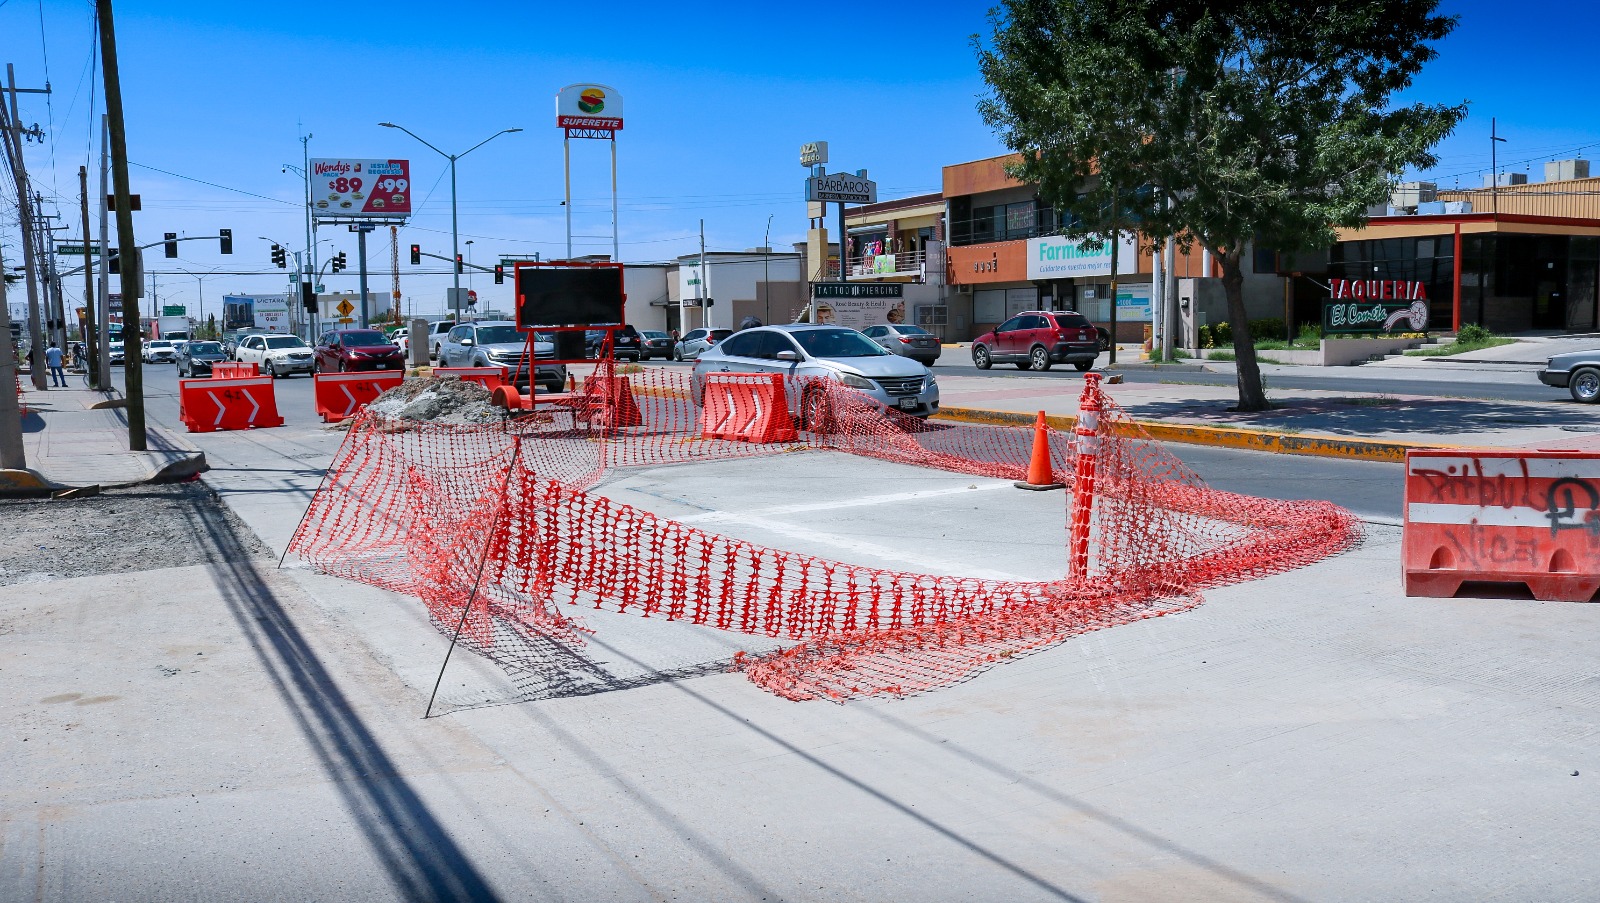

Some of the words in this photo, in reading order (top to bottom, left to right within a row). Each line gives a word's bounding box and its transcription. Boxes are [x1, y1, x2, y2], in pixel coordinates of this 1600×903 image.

[562, 117, 620, 127] SUPERETTE
[314, 160, 351, 175] Wendy's
[328, 177, 363, 193] $89
[378, 178, 408, 193] $99
[817, 179, 870, 193] BÁRBAROS
[817, 286, 850, 295] TATTOO
[861, 286, 899, 295] PIERCING
[1328, 278, 1427, 303] TAQUERIA
[1331, 303, 1346, 326] El
